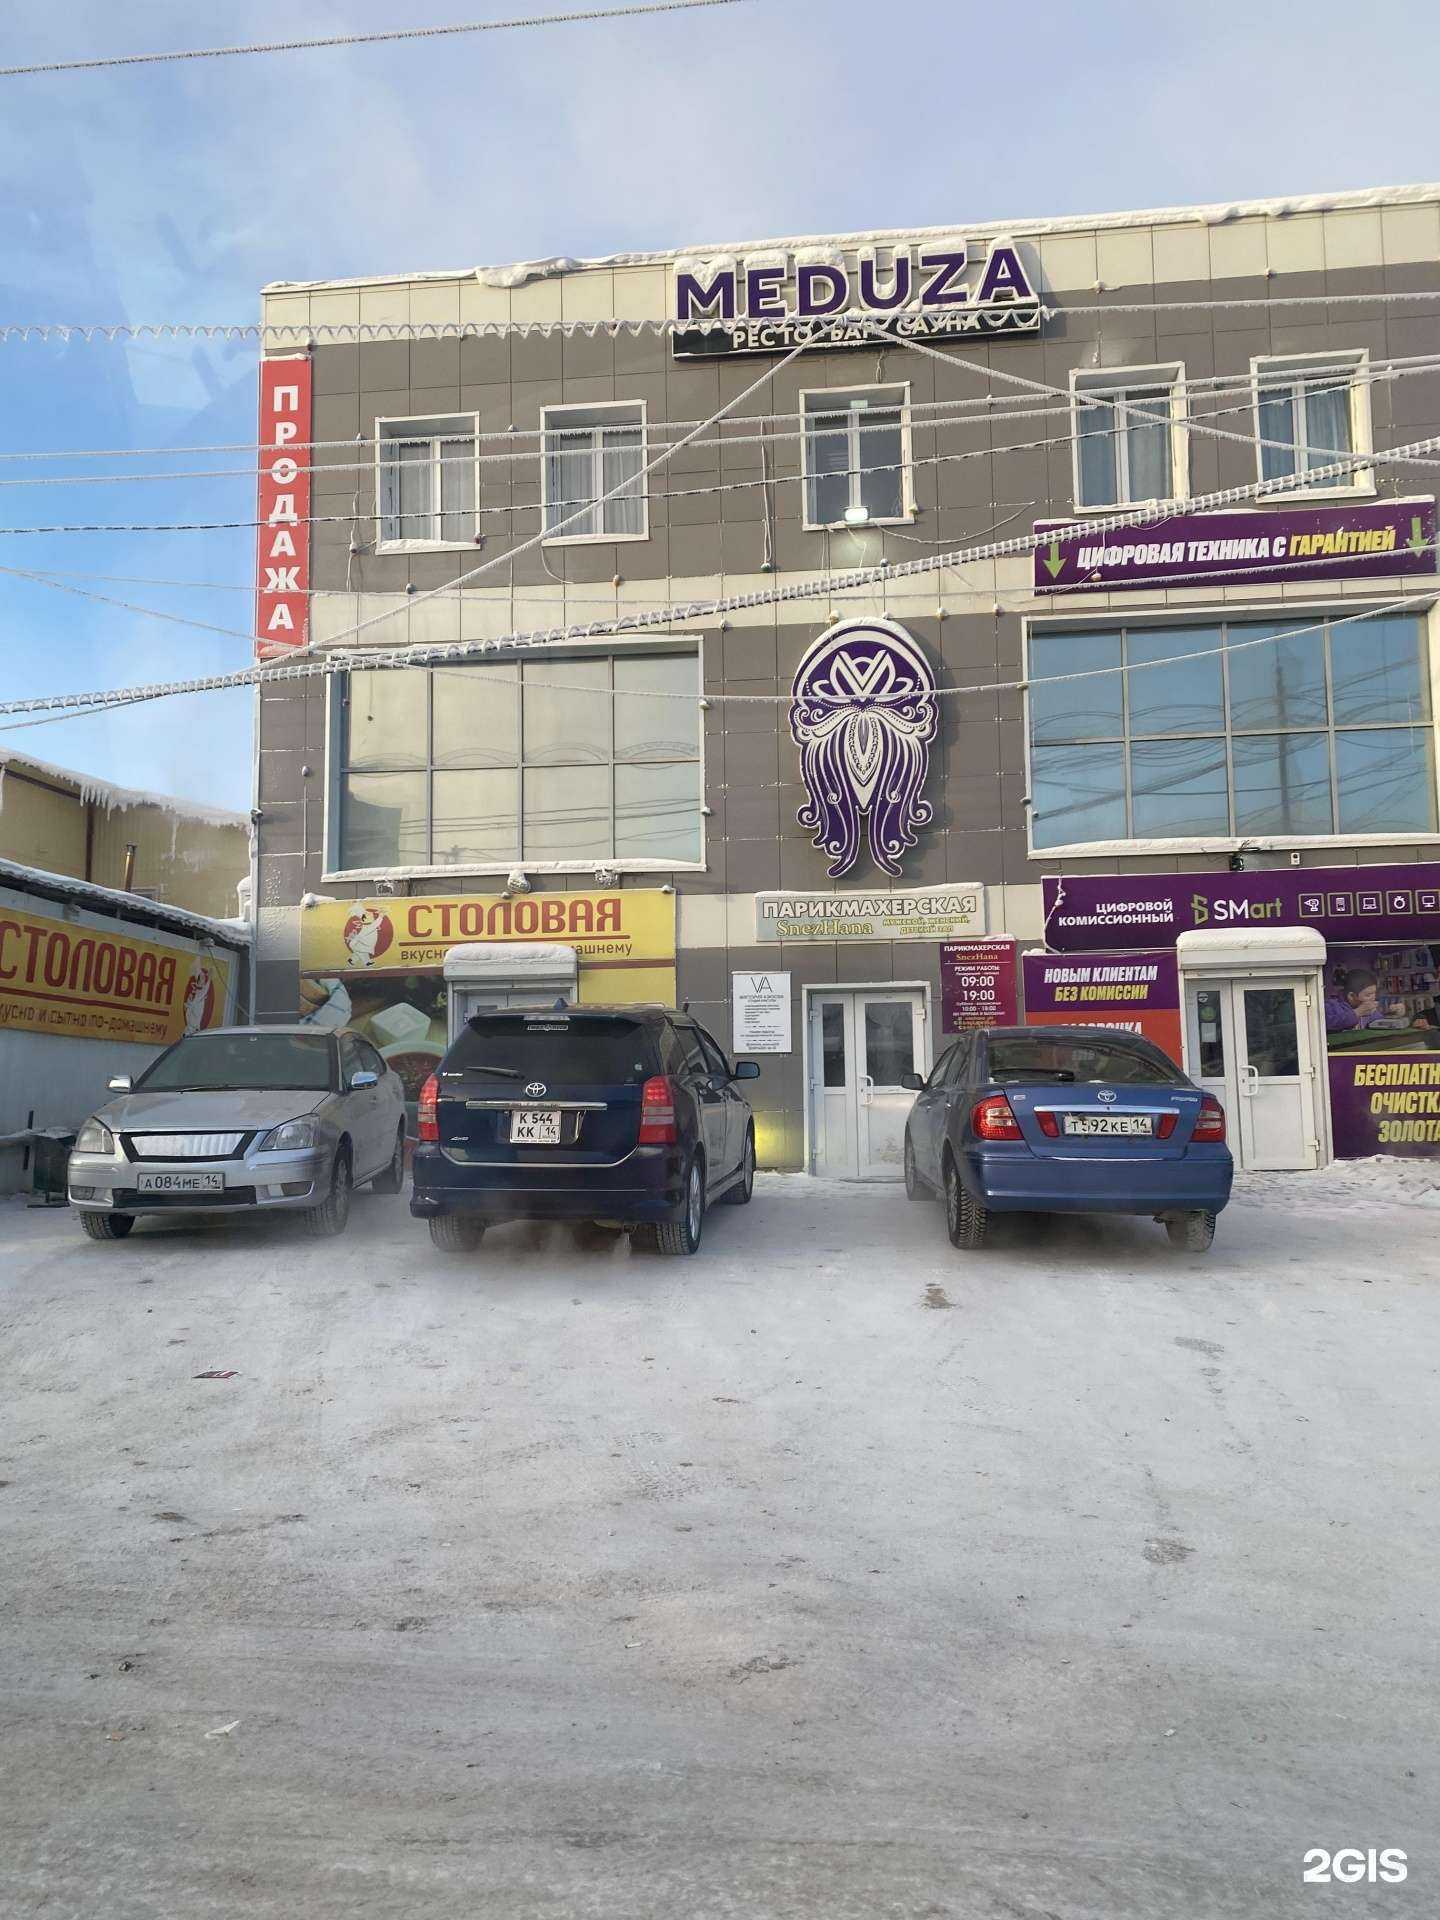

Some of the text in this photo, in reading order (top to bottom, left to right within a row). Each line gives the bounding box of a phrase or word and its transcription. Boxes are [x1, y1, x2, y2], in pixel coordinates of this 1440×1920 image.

[674, 244, 1035, 321] MEDUZA
[896, 313, 982, 337] САУНА
[263, 384, 301, 631] ПРОДАЖА
[1076, 524, 1396, 570] ЦИФРОВАЯ ТЕХНИКА С ГАРАНТИЕЙ
[763, 895, 977, 918] ПАРИКМАХЕРСКАЯ
[1096, 898, 1173, 915] ЦИФРОВОЙ
[1214, 897, 1283, 921] SMart
[408, 898, 622, 938] СТОЛОВАЯ
[777, 918, 874, 936] SnezHana
[1058, 911, 1174, 927] КОМИССИОННЫЙ
[944, 944, 1010, 952] ПАРИКМАХЕРСКАЯ
[956, 953, 998, 961] SnezHana
[0, 919, 177, 1006] СТОЛОВАЯ
[961, 976, 995, 987] 09:00
[1044, 965, 1158, 984] НОВЫМ КЛИЕНТАМ
[963, 989, 995, 1001] 19:00
[1055, 984, 1149, 1002] БЕЗ КОМИССИИ
[531, 1113, 553, 1124] 544
[517, 1126, 535, 1137] КК
